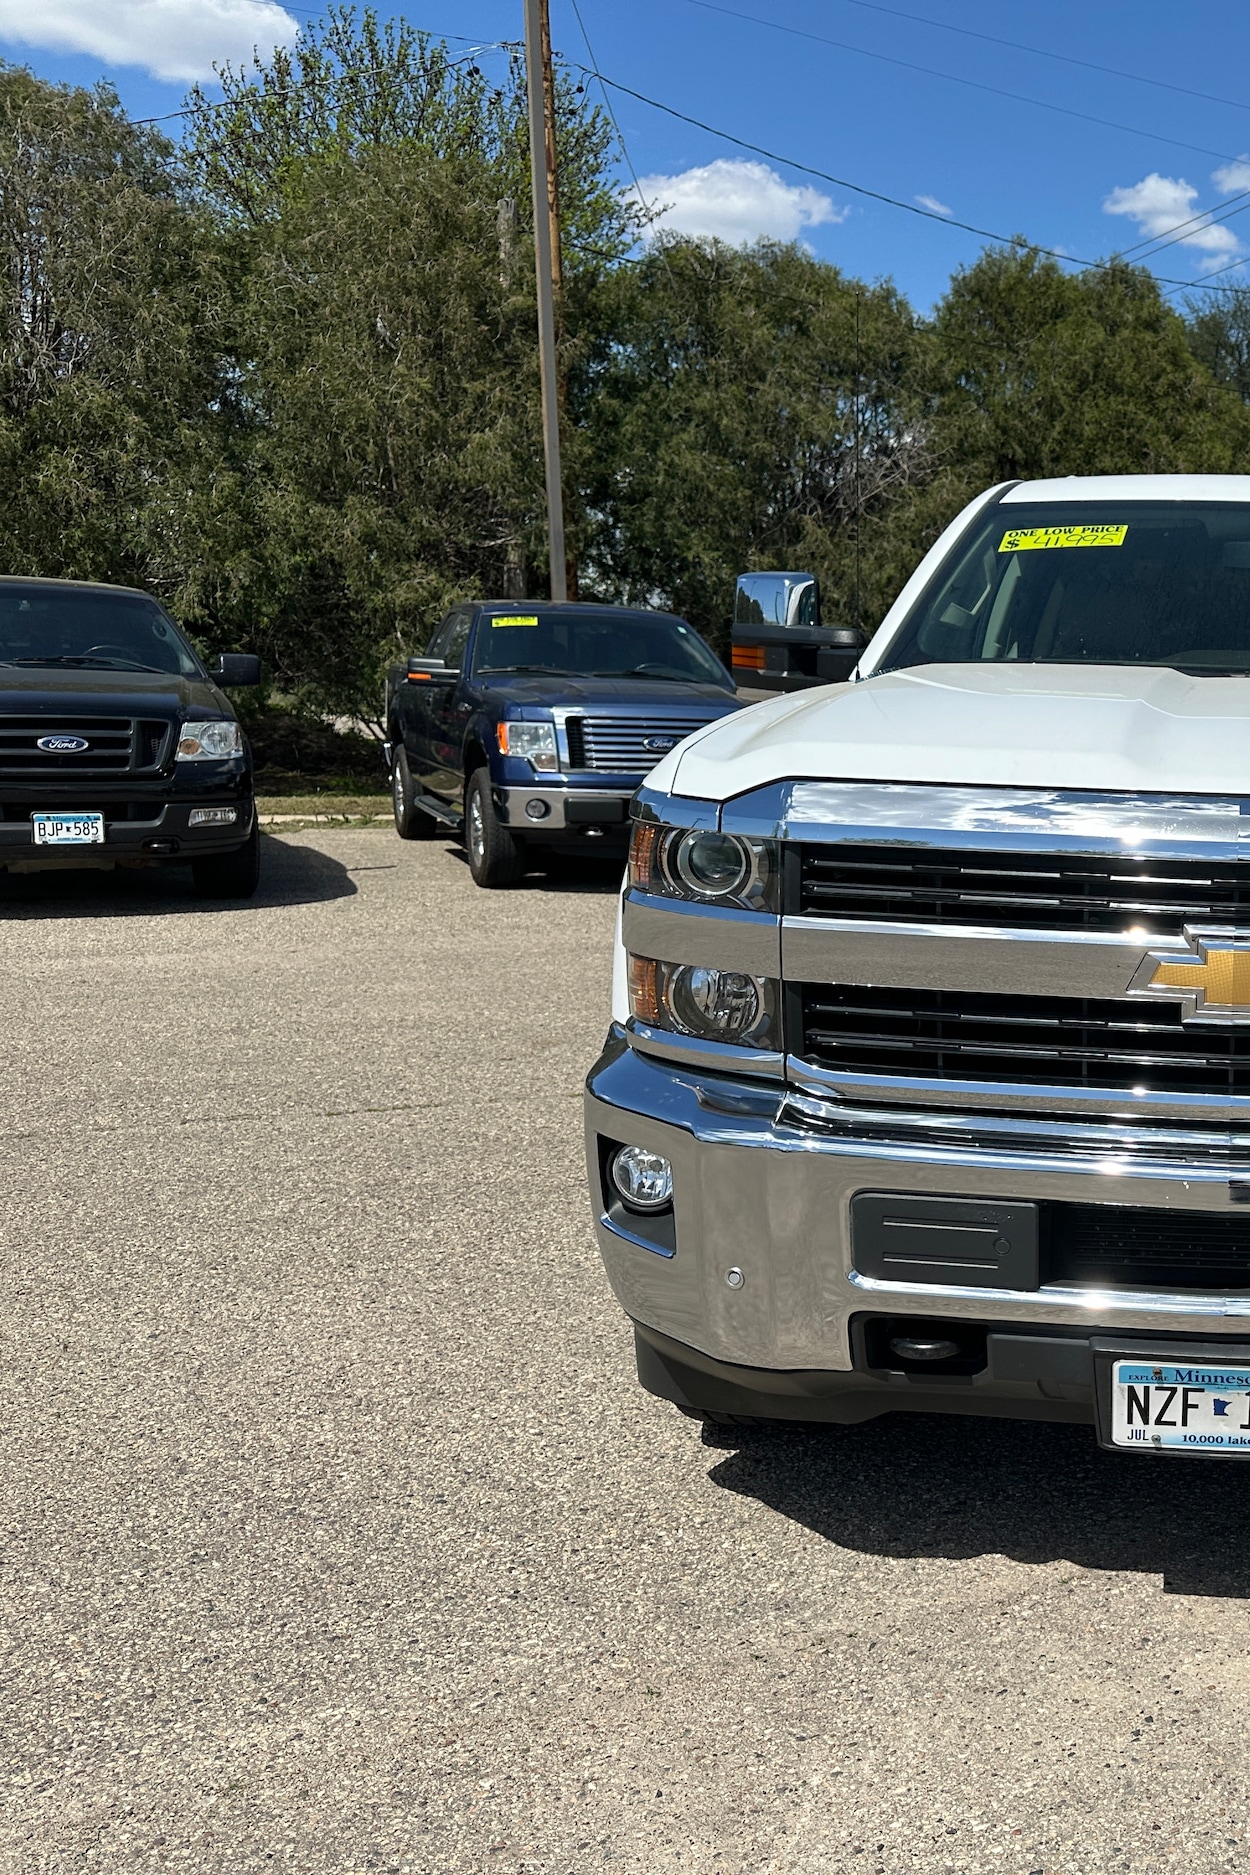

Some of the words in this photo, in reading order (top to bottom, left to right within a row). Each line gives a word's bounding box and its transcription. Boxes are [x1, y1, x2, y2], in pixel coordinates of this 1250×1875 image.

[1008, 529, 1038, 538] ONE
[1044, 527, 1076, 536] LOW
[1081, 525, 1124, 534] PRICE
[1005, 538, 1020, 549] $
[1033, 533, 1118, 548] 41,995
[48, 738, 77, 749] Ford
[652, 738, 674, 748] Ford
[38, 822, 63, 837] BJP
[73, 821, 99, 836] 585
[1128, 1373, 1169, 1382] EXPLORE
[1126, 1385, 1206, 1427] NZF
[1127, 1428, 1149, 1441] JUL
[1182, 1434, 1225, 1445] 10,000
